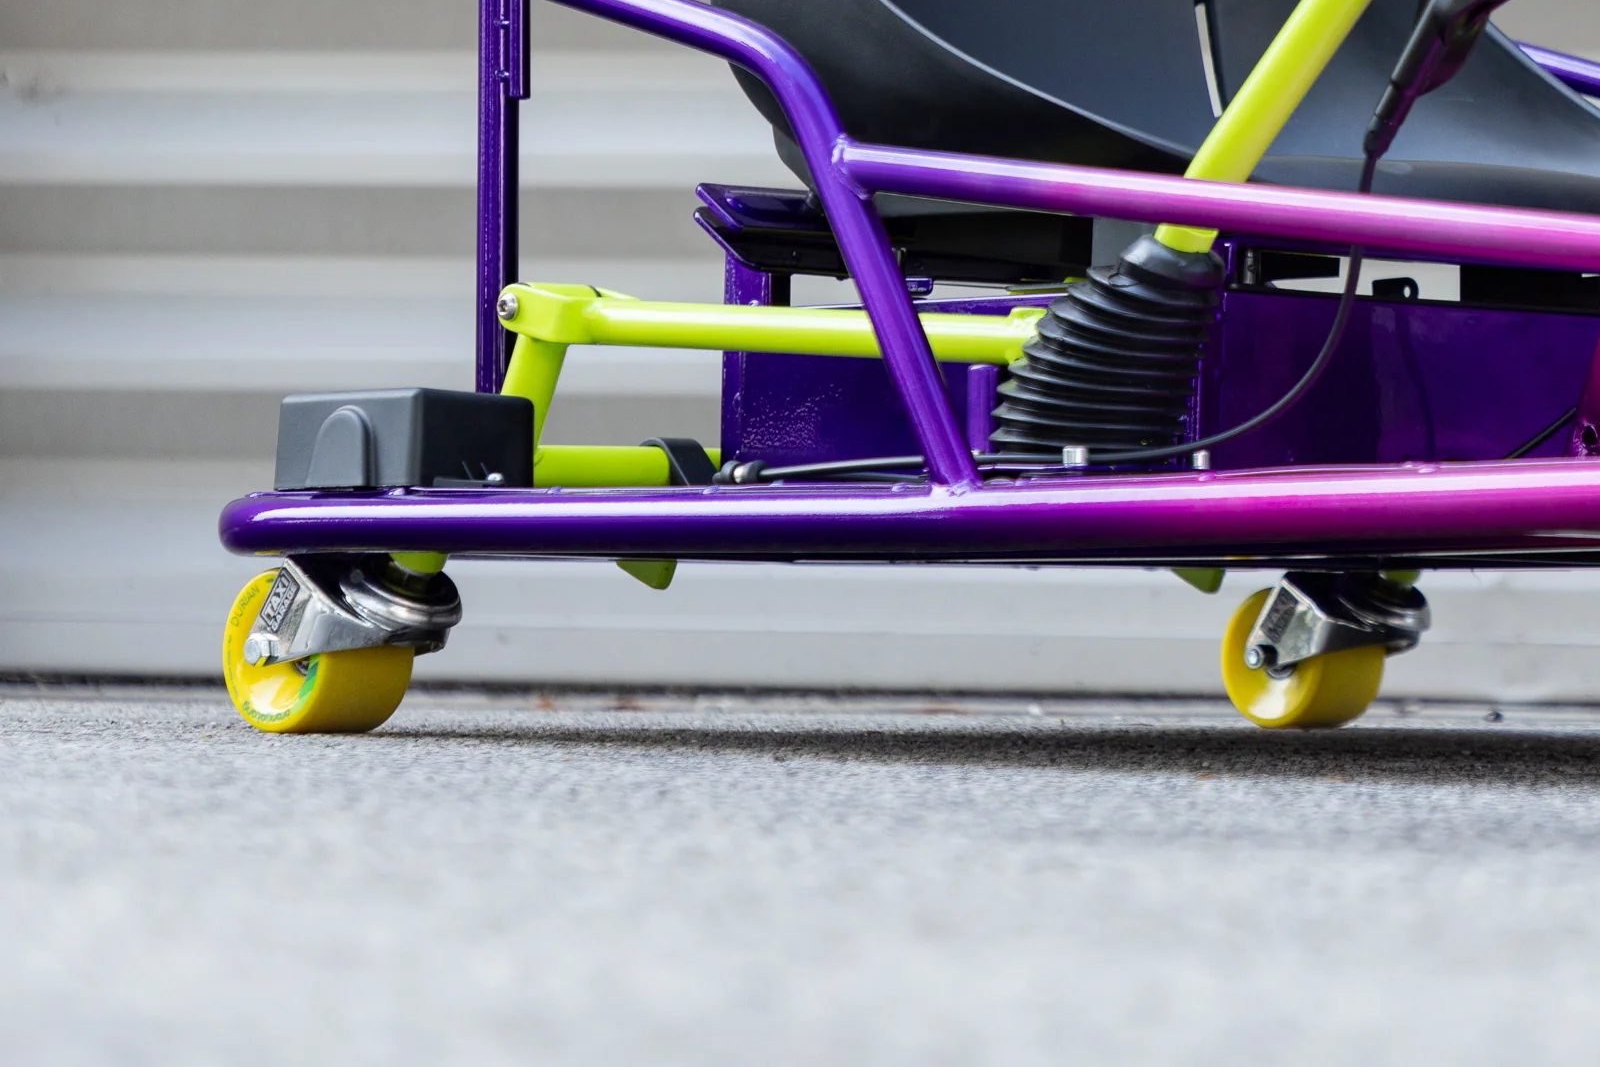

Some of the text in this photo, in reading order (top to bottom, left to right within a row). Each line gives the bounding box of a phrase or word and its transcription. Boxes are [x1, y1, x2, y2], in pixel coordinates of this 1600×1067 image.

[230, 585, 260, 627] DURIAN
[264, 576, 288, 616] TAXI
[271, 582, 298, 631] GARAGE
